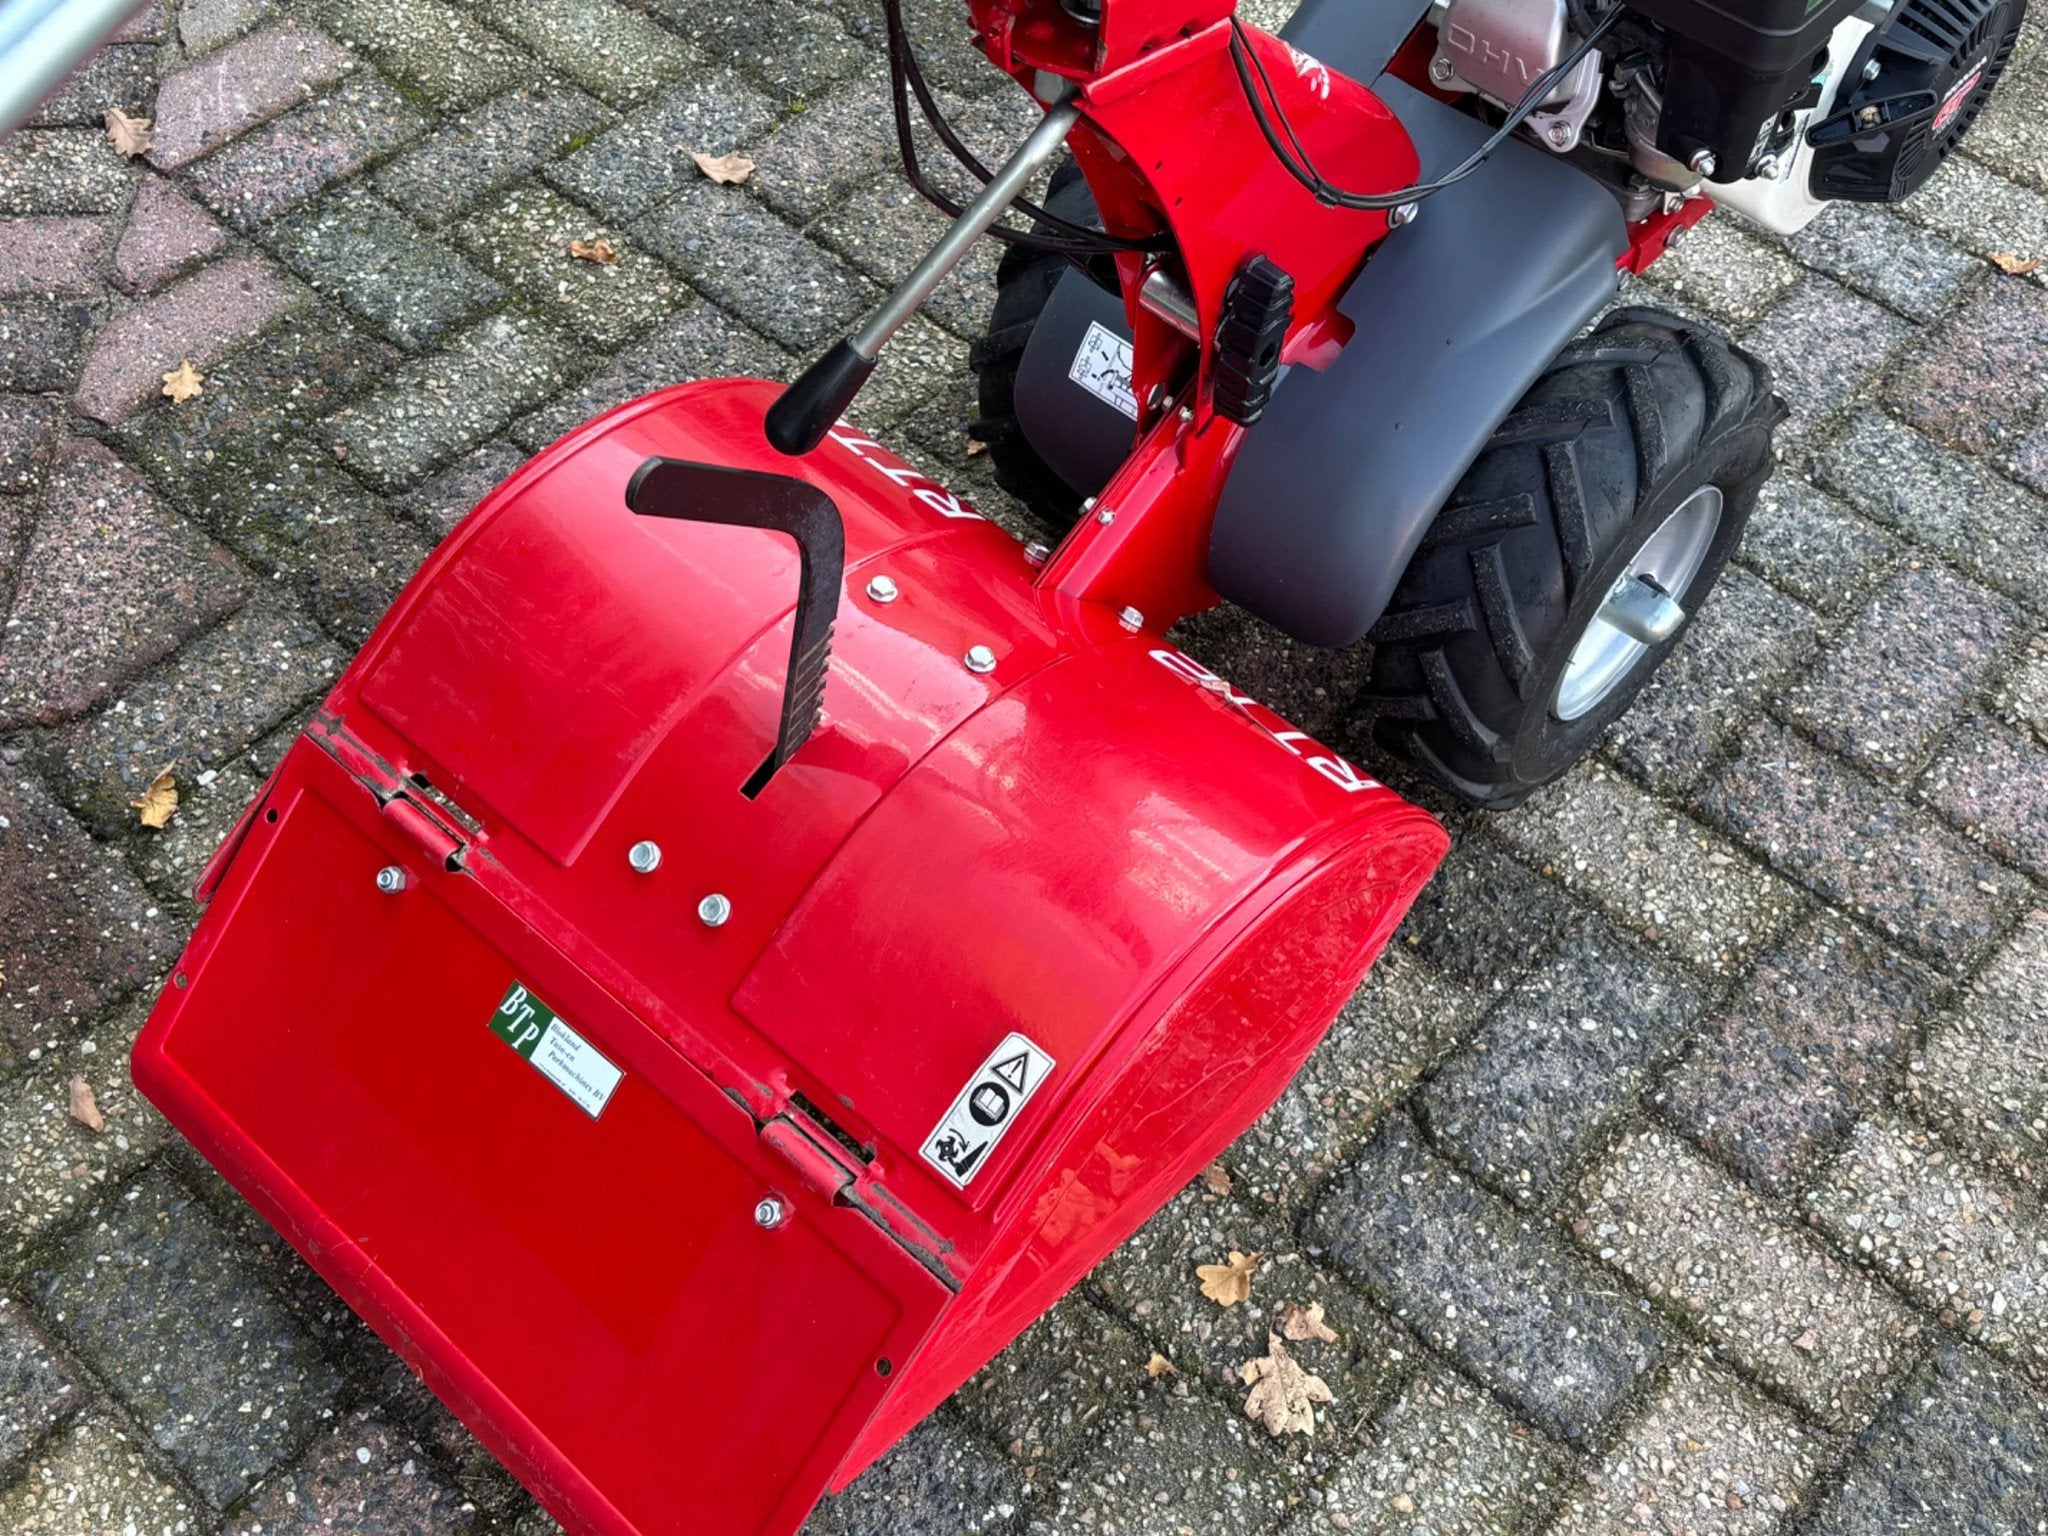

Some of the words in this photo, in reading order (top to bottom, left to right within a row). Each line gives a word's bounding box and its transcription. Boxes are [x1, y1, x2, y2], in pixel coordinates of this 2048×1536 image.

[828, 418, 987, 521] RTT
[500, 985, 540, 1050] BTP
[547, 1050, 593, 1092] Parkmachines
[592, 1089, 606, 1101] BV
